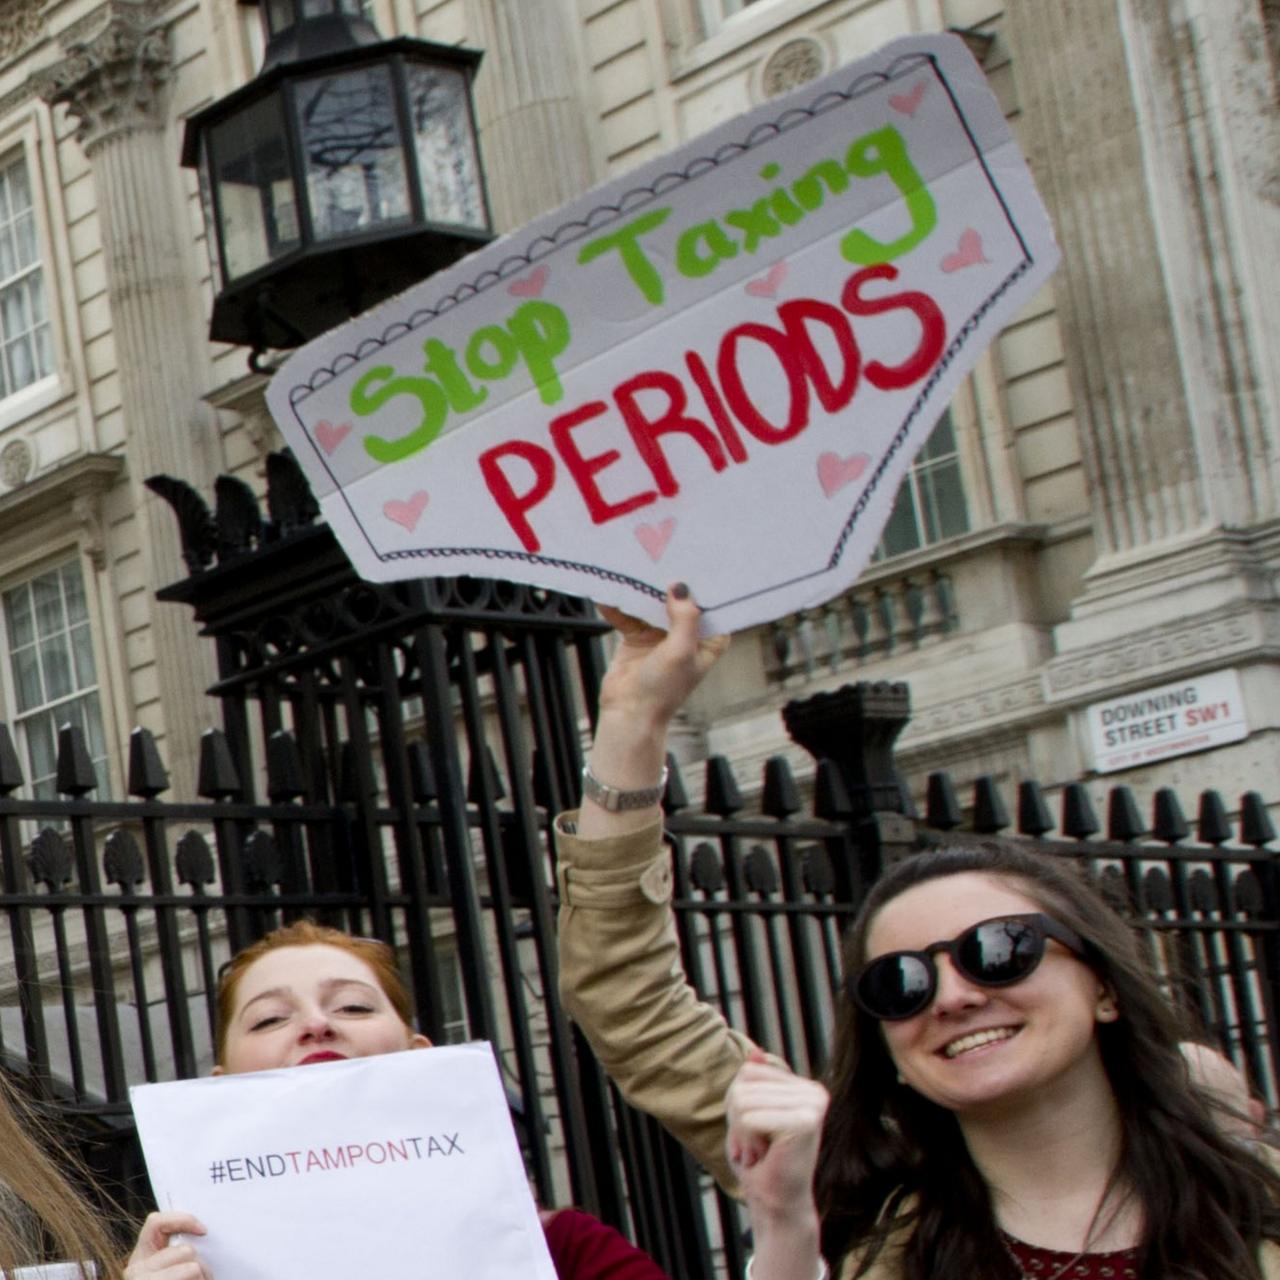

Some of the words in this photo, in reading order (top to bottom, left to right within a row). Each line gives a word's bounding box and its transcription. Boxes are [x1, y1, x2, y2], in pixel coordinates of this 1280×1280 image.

[348, 299, 570, 464] Stop
[578, 123, 939, 307] Taxing
[477, 263, 947, 554] PERIODS
[1101, 687, 1198, 726] DOWNING
[1104, 713, 1178, 747] STREET
[1185, 702, 1230, 727] SW1
[209, 1132, 464, 1184] #ENDTAMPONTAX
